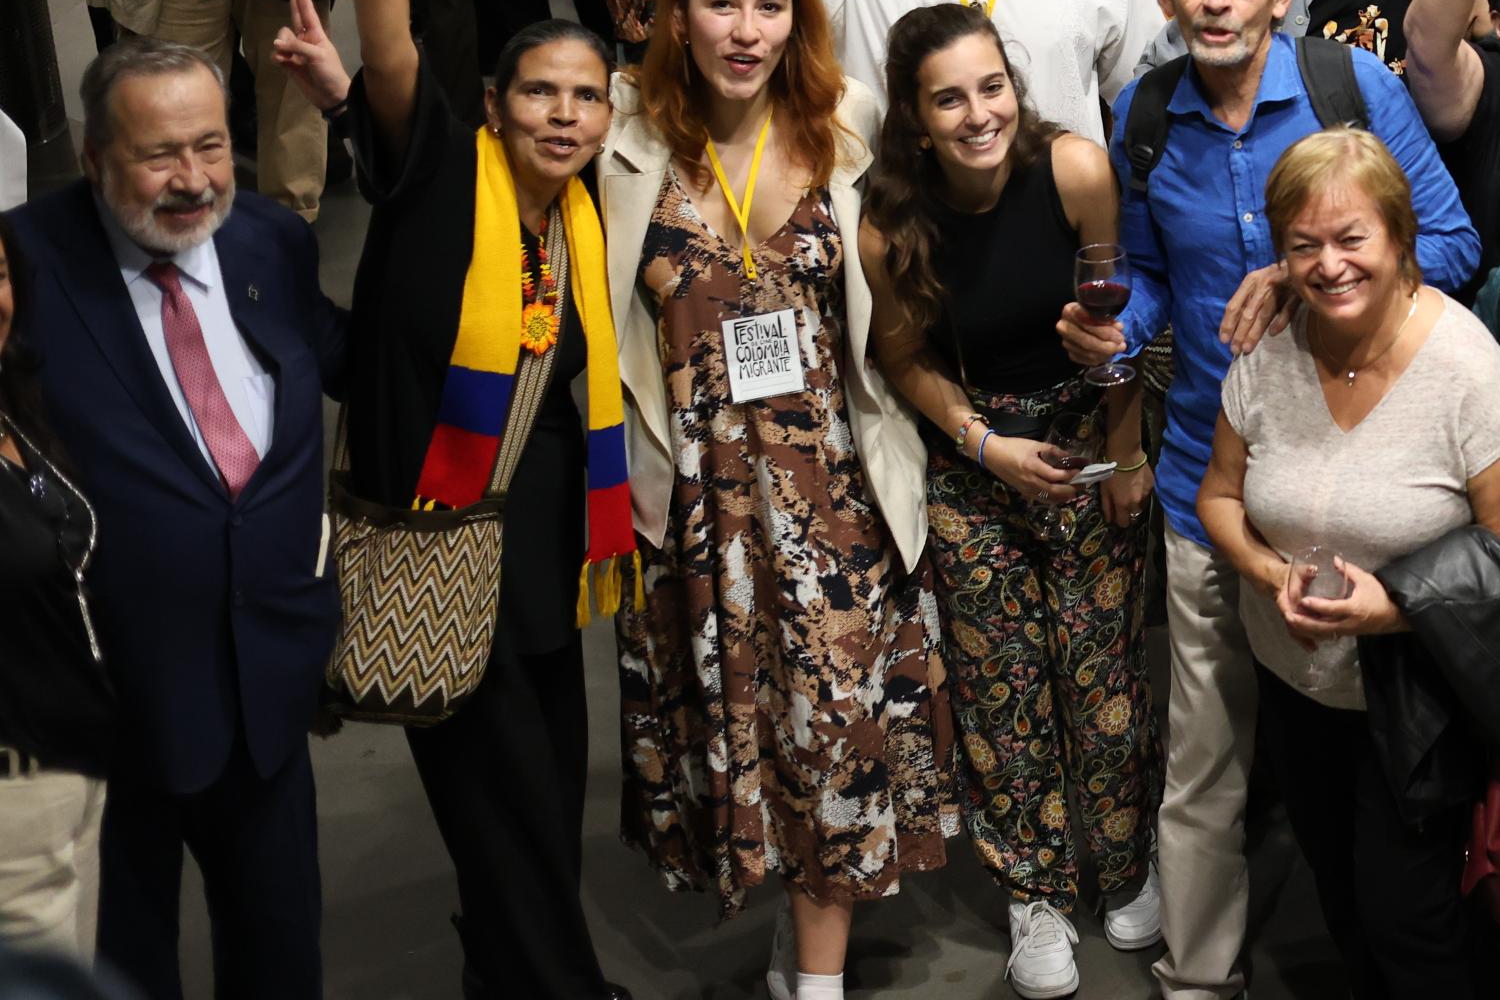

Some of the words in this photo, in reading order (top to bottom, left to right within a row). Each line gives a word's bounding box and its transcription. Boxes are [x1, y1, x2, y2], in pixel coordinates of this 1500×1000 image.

[733, 314, 788, 345] FESTIVAL
[736, 339, 790, 363] COLOMBIA
[739, 357, 791, 380] MIGRANTE
